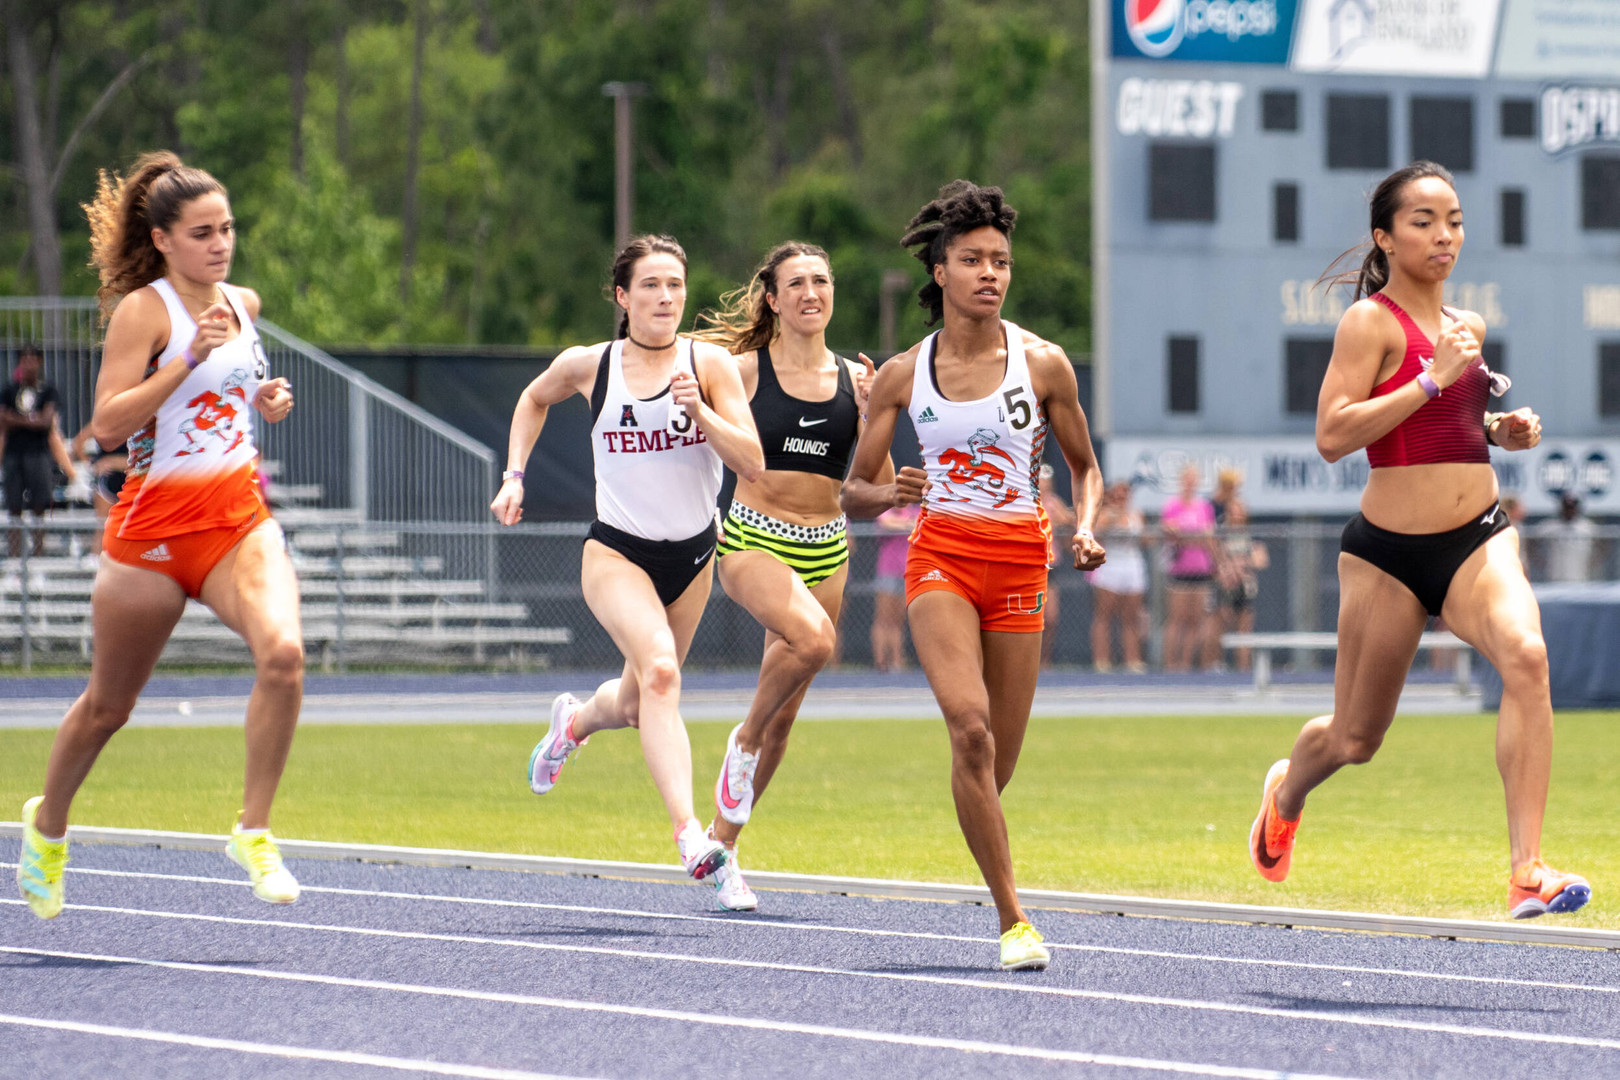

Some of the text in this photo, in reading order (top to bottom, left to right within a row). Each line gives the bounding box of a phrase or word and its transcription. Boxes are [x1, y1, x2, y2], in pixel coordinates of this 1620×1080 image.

[1117, 77, 1243, 137] GUEST
[1003, 386, 1031, 430] 5
[783, 436, 830, 456] HOUNDS
